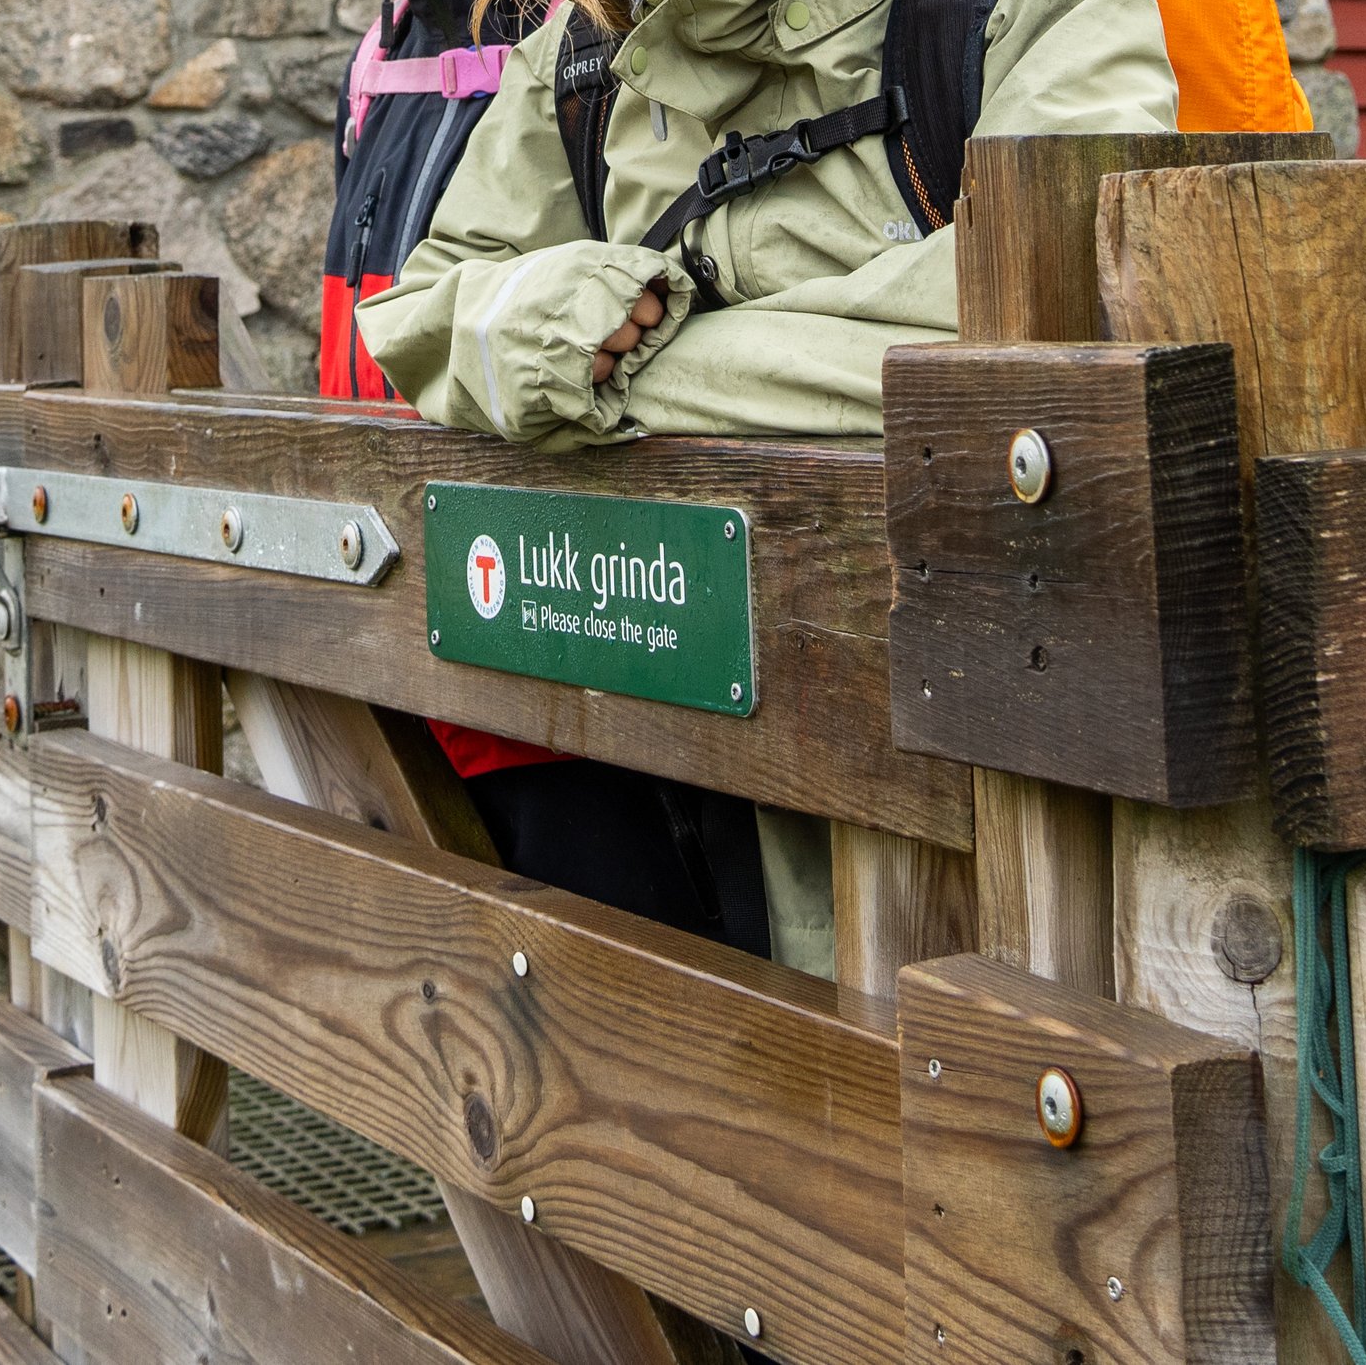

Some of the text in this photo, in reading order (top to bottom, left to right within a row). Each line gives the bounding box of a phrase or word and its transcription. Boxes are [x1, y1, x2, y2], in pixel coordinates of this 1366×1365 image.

[563, 55, 604, 80] OSPREY
[519, 531, 686, 611] Lukk grinda
[540, 603, 678, 653] Please close the gate
